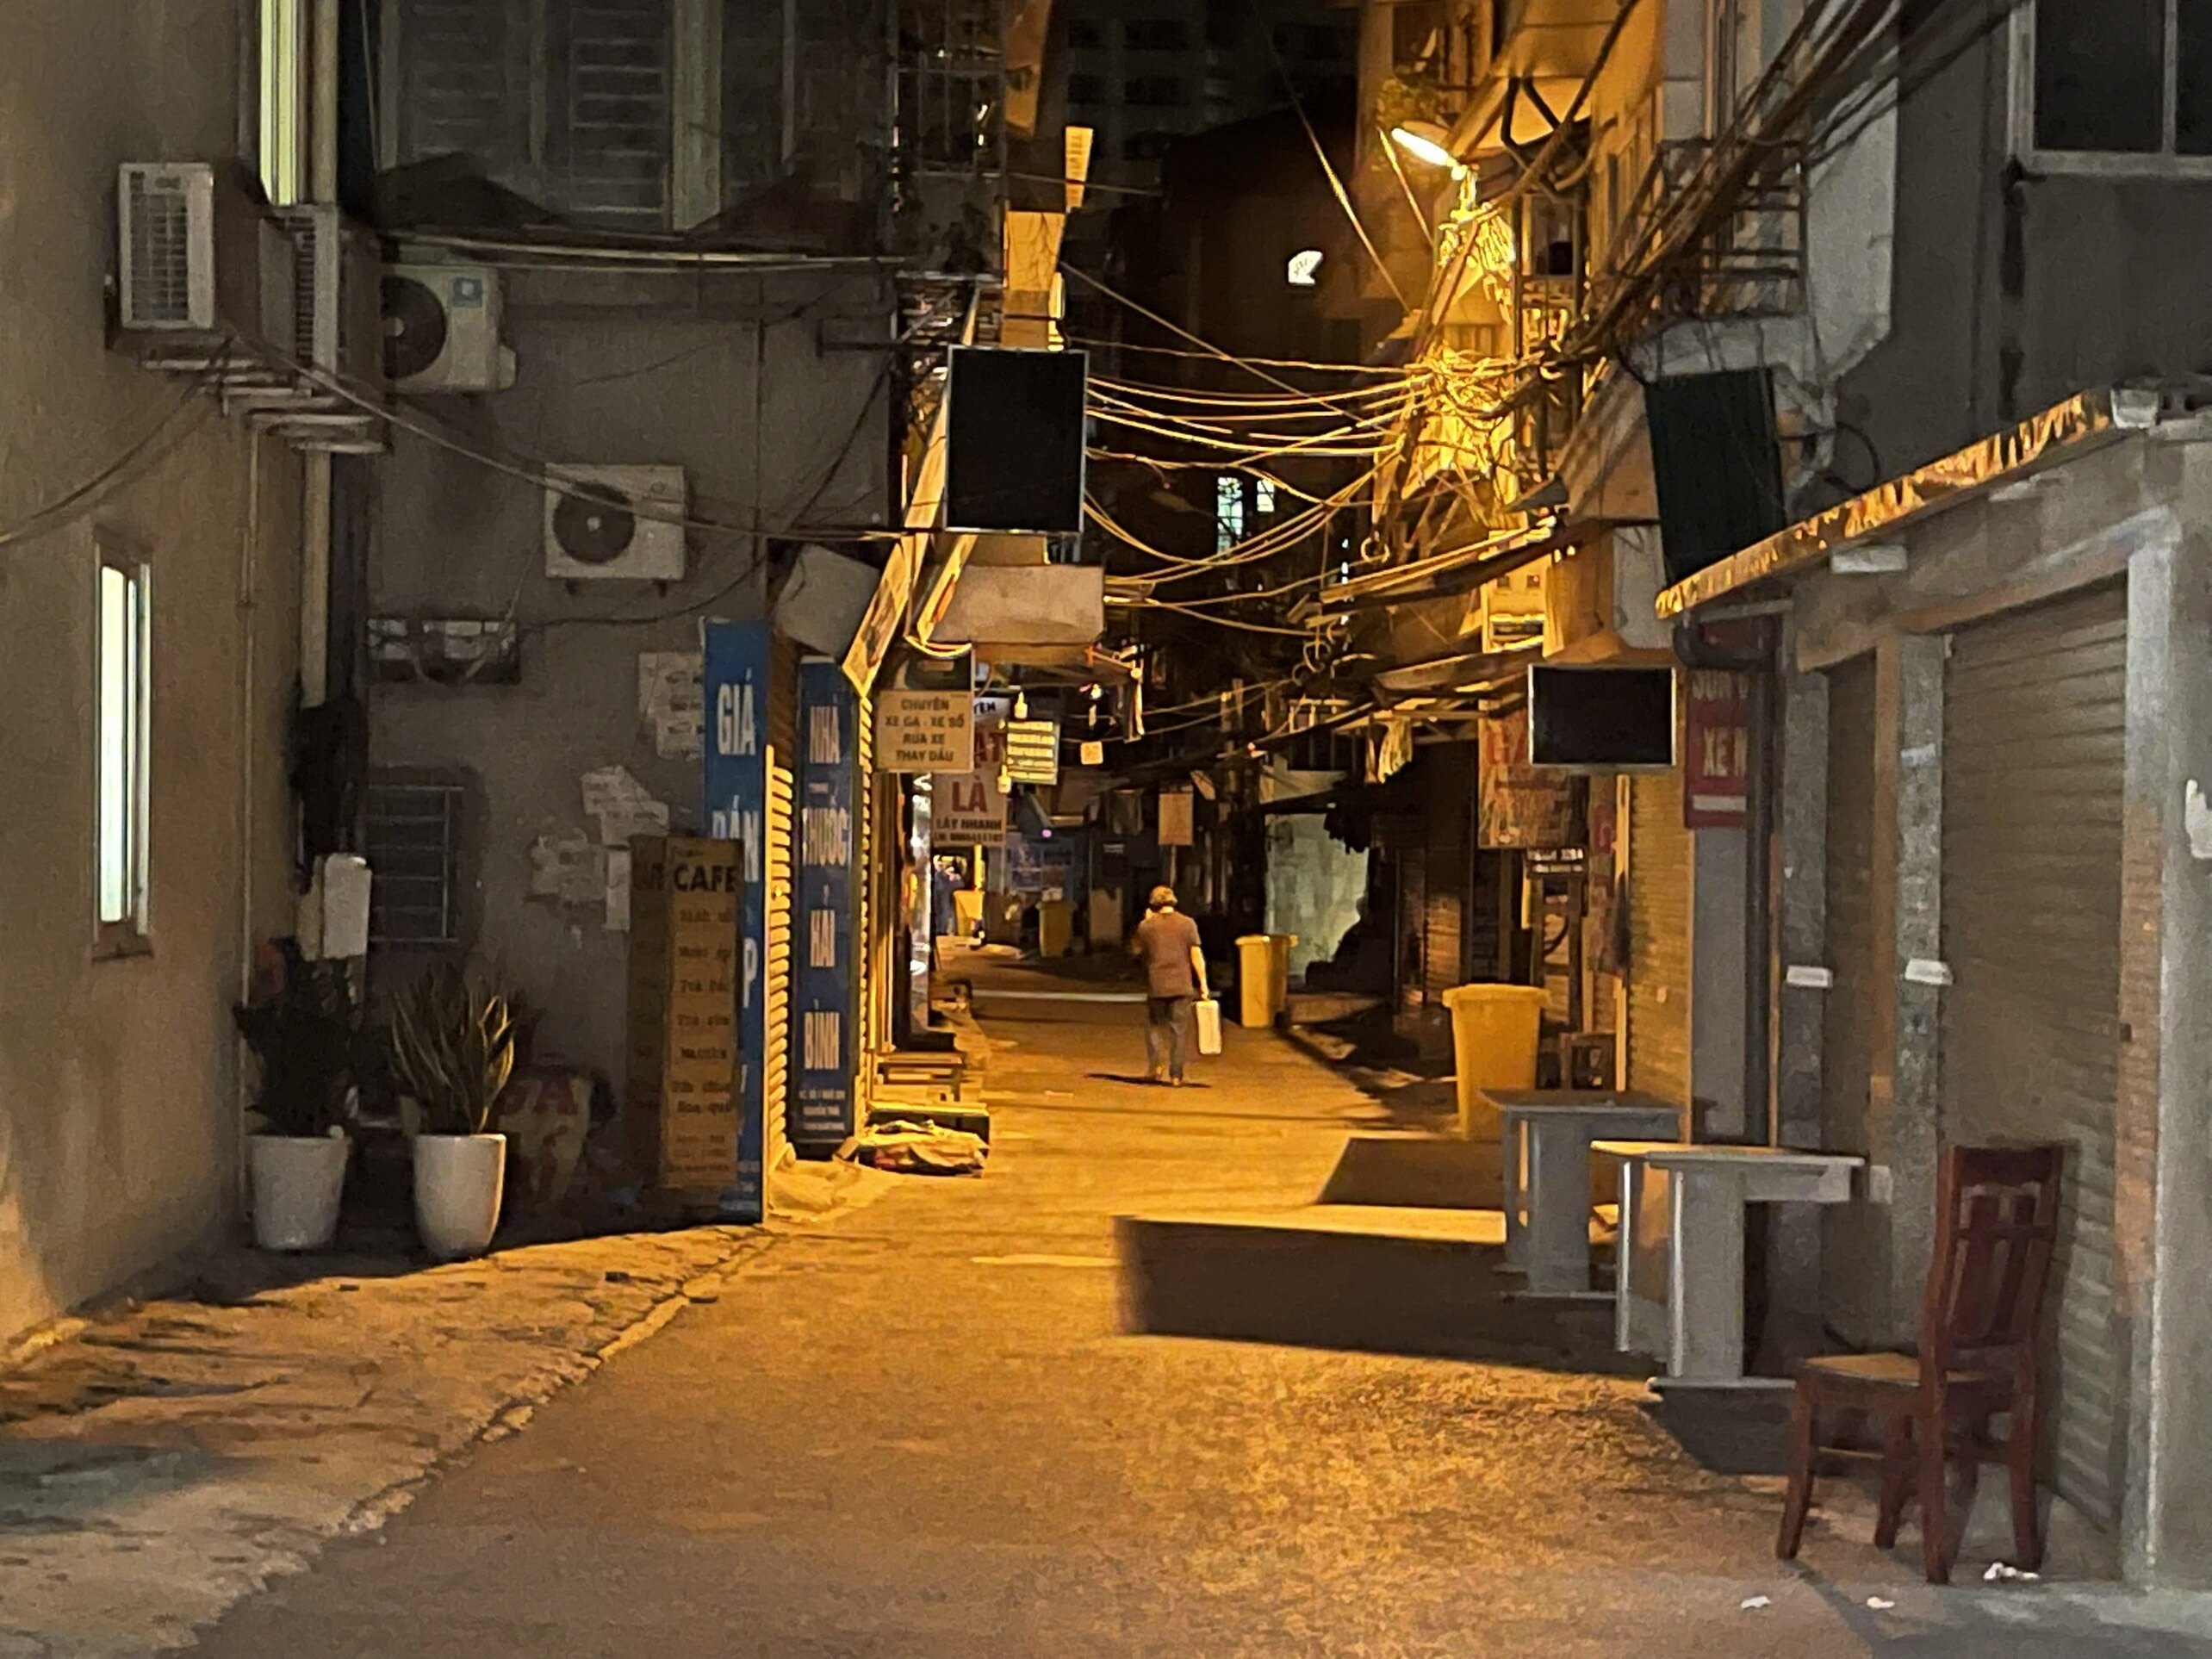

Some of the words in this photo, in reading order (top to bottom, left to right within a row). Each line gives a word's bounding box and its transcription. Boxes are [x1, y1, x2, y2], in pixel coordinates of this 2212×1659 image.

[717, 668, 755, 755] GIÁ
[885, 716, 900, 727] XE
[904, 716, 920, 727] GA
[930, 716, 945, 727] XE
[948, 713, 965, 728] SỐ
[901, 697, 950, 711] CHUYÊN
[896, 749, 925, 761] THAY
[930, 734, 946, 744] XE
[1704, 727, 1728, 776] XE
[952, 777, 987, 812] LÀ
[810, 884, 836, 968] HẢI
[804, 997, 841, 1070] BÌNH
